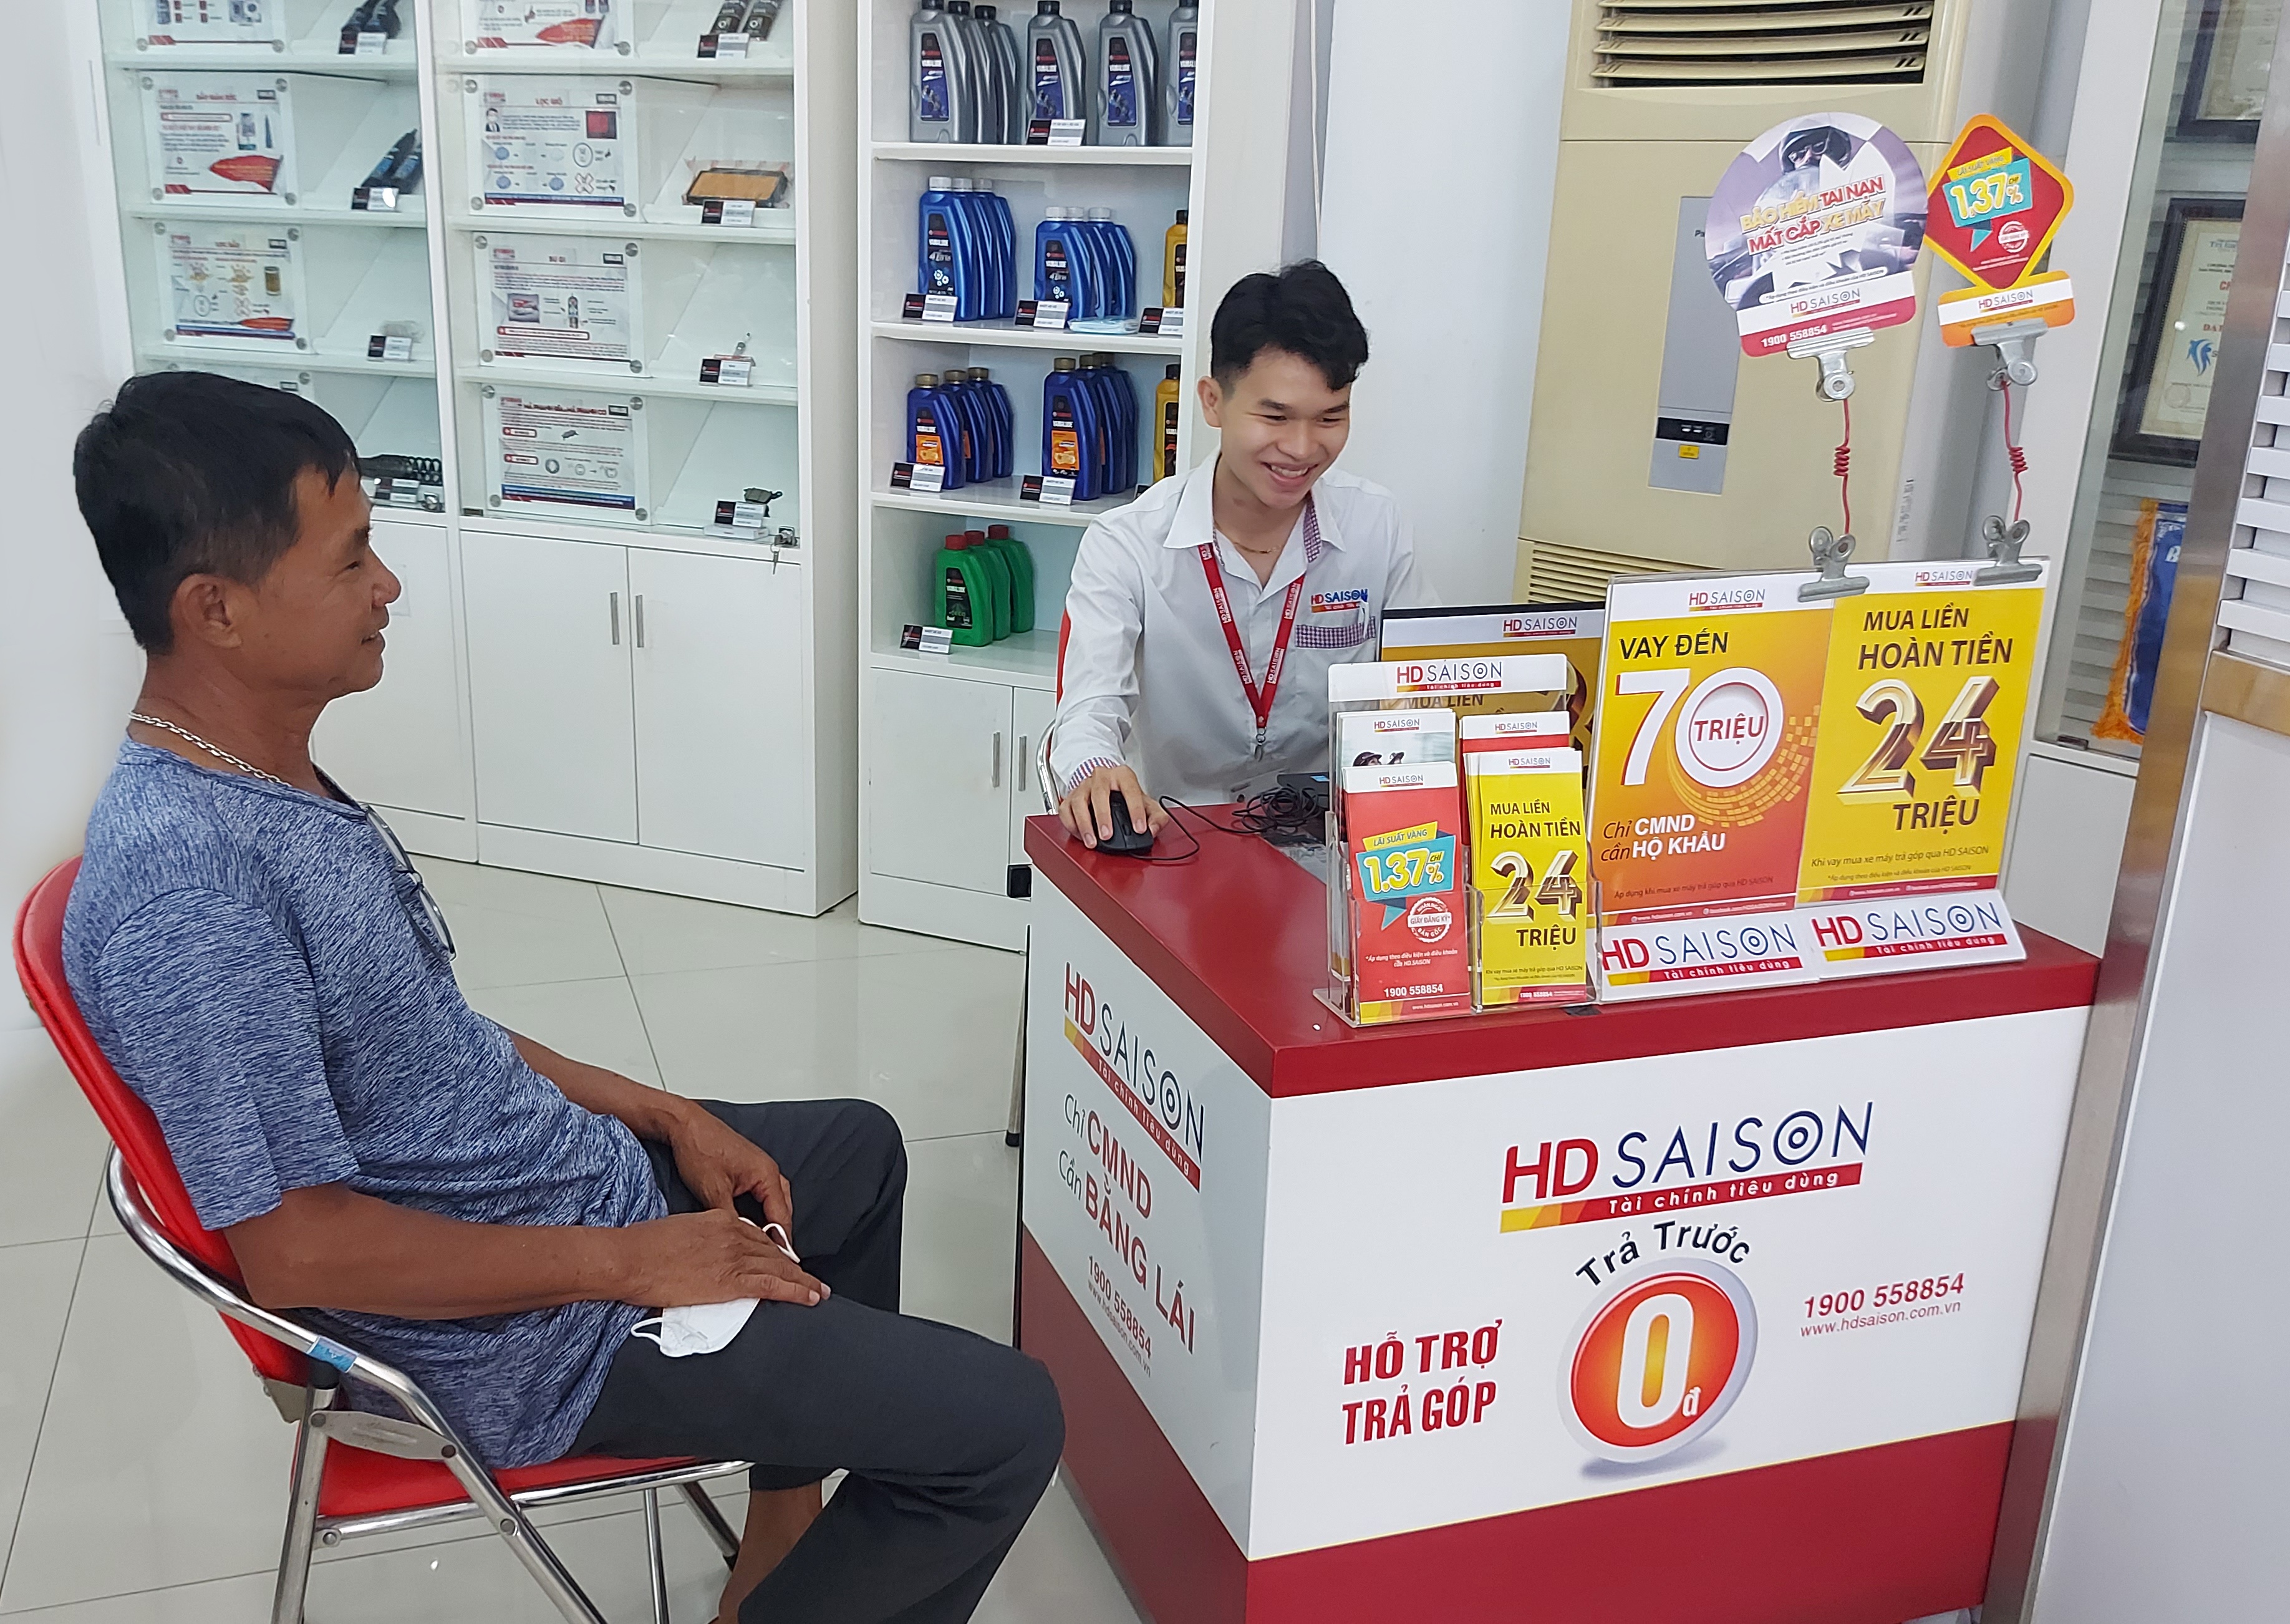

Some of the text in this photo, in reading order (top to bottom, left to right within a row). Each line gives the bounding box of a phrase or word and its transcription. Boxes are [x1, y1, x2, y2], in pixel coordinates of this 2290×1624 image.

[1742, 176, 1883, 231] BẢO HIỂM TAI NẠN
[1749, 226, 1783, 253] MẤT
[1823, 213, 1844, 231] XE
[1791, 289, 1860, 313] HD SAISON
[1978, 290, 2033, 309] HD SAISON
[1761, 324, 1827, 347] 1900 558854
[1915, 571, 1973, 581] HD SAISON
[1311, 589, 1368, 604] HD SAISON
[1689, 589, 1765, 606] HD SAISON
[1503, 617, 1577, 631] HD SAISON
[1863, 602, 1969, 632] MUA LIỀN
[1619, 627, 1729, 660] VAY ĐẾN
[1857, 631, 2013, 670] HOÀN TIỀN
[1396, 662, 1502, 684] HD SAISON
[1374, 718, 1420, 730] HD SAISON
[1507, 722, 1537, 730] SAISON
[1615, 667, 1784, 788] 70
[1694, 713, 1764, 745] TRIỆU
[1836, 675, 1999, 805] 24
[1379, 775, 1423, 785] HD SAISON
[1490, 799, 1550, 815] MUA LIỀN
[1892, 795, 1981, 835] TRIỆU
[1374, 829, 1427, 846] LÃI SUẤT VÀNG
[1490, 817, 1581, 838] HOÀN TIỀN
[1603, 813, 1696, 839] Chỉ CMND
[1601, 830, 1726, 862] cần HỘ KHẨU
[1811, 857, 1826, 868] Khi
[1875, 853, 1893, 864] máy
[1908, 851, 1924, 862] góp
[1925, 851, 1941, 860] qua
[1943, 848, 1956, 857] HD
[1958, 845, 1989, 856] SAISON
[1486, 850, 1582, 924] 24
[1516, 924, 1577, 950] TRIỆU
[1811, 902, 2003, 947] HD SAISON
[1602, 923, 1798, 970] HD SAISON
[1664, 971, 1684, 980] Tài
[1689, 966, 1724, 978] chính
[1759, 959, 1790, 971] dùng
[1384, 984, 1443, 997] 1900 558854
[1065, 962, 1204, 1163] HD SAISON
[1098, 1058, 1190, 1176] Tài chính tiêu dùng
[1065, 1094, 1152, 1219] Chỉ CMND
[1502, 1101, 1873, 1204] HD SAISON
[1609, 1171, 1839, 1214] Tài chính tiêu dùng
[1059, 1149, 1195, 1355] Cần BẰNG LÁI
[1575, 1220, 1751, 1287] Trả Trước
[1088, 1255, 1152, 1359] 1900 558854
[1804, 1272, 1965, 1318] 1900 558854
[1088, 1279, 1151, 1378] www.hdsaison.com.vn
[1800, 1300, 1961, 1337] www.hdsaison.com.vn
[1343, 1318, 1502, 1385] HỖ TRỢ
[1341, 1376, 1497, 1446] TRẢ GÓP
